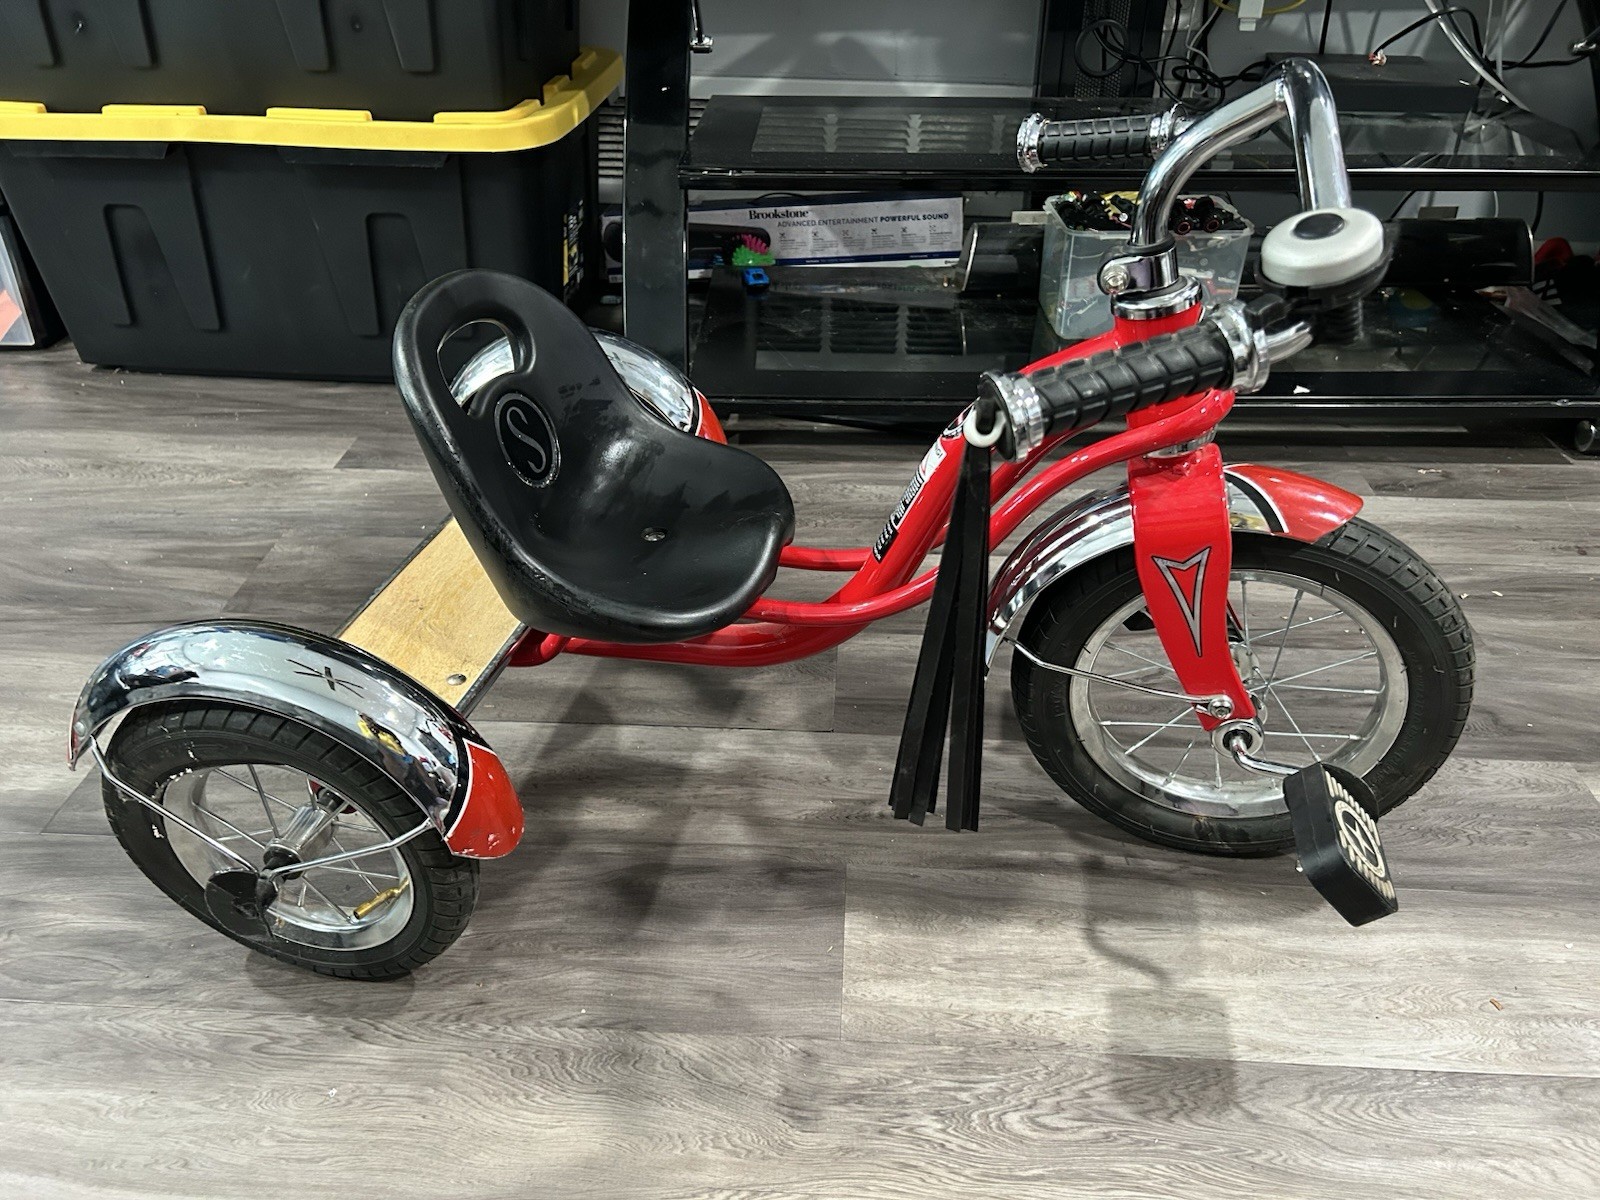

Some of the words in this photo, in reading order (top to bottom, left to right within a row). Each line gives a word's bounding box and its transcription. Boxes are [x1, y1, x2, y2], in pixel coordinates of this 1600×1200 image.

[749, 209, 809, 220] Brookstone
[777, 219, 816, 227] ADVANCED
[818, 216, 878, 226] ENTERTAINMENT
[880, 214, 920, 223] POWERFUL
[922, 213, 949, 221] SOUND
[506, 406, 547, 474] S
